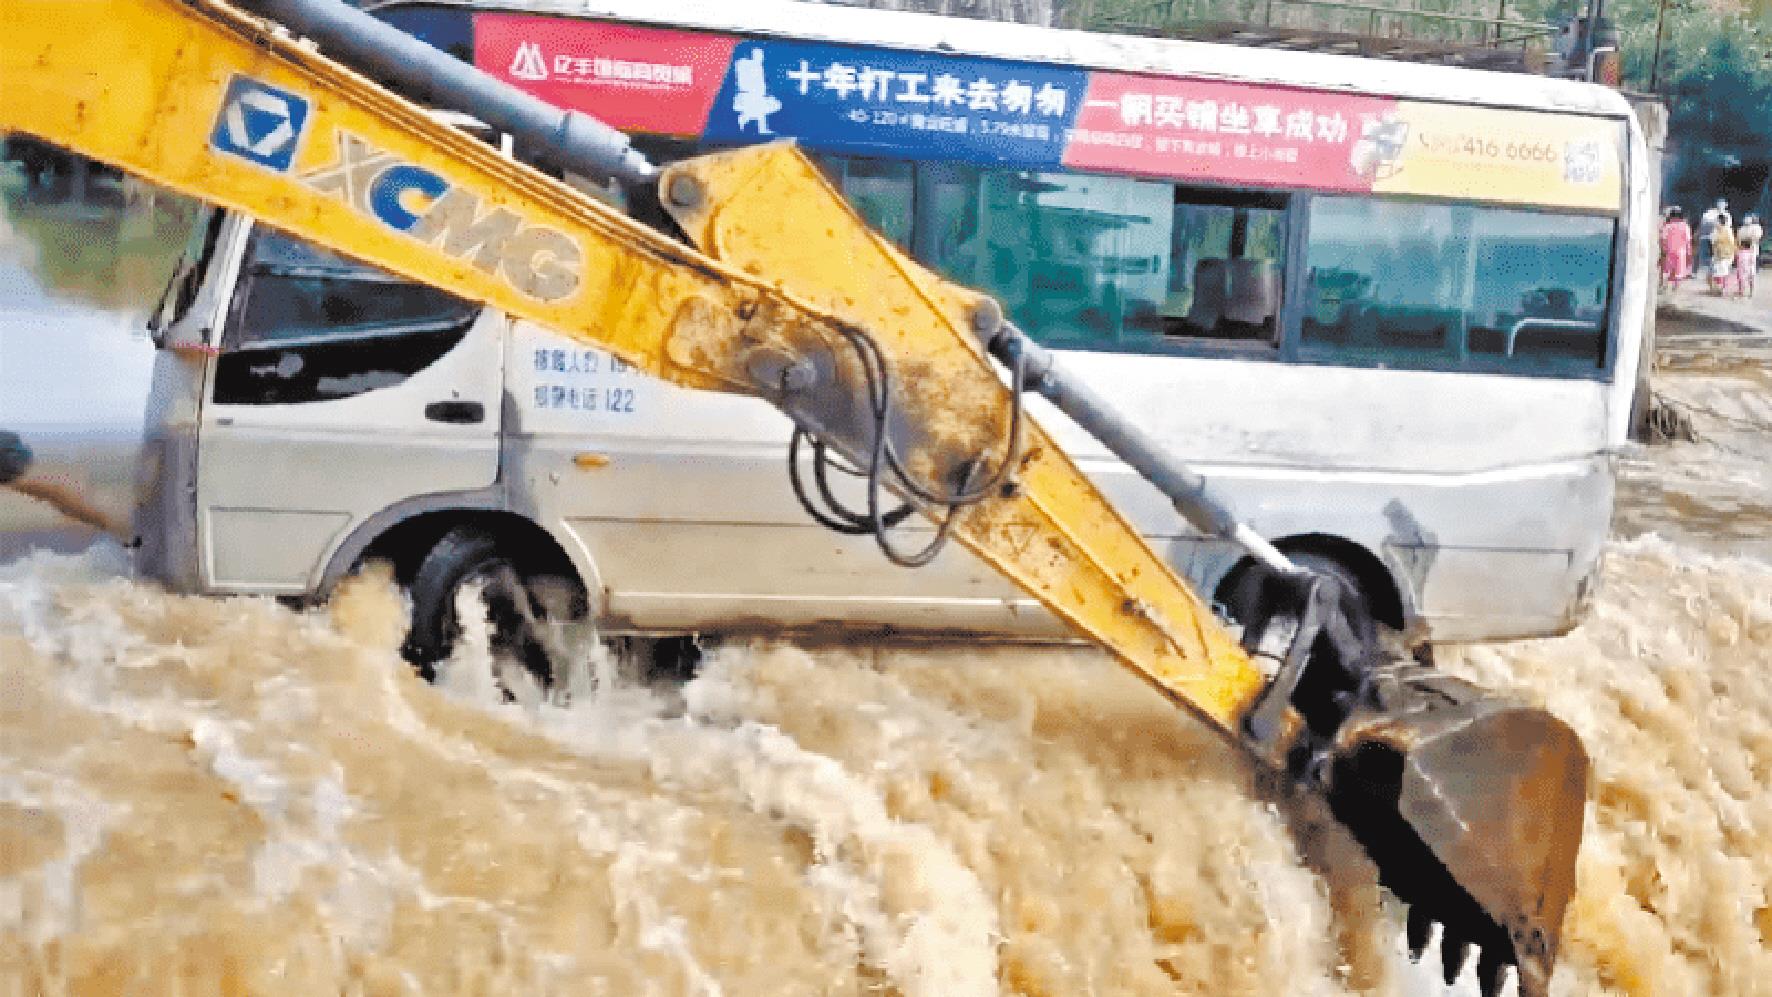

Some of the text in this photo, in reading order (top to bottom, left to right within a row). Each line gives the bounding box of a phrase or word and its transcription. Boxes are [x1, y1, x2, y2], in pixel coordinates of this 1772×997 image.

[786, 59, 1067, 117] 十年打工来去匆匆
[294, 130, 583, 304] XCMG
[605, 387, 634, 413] 122
